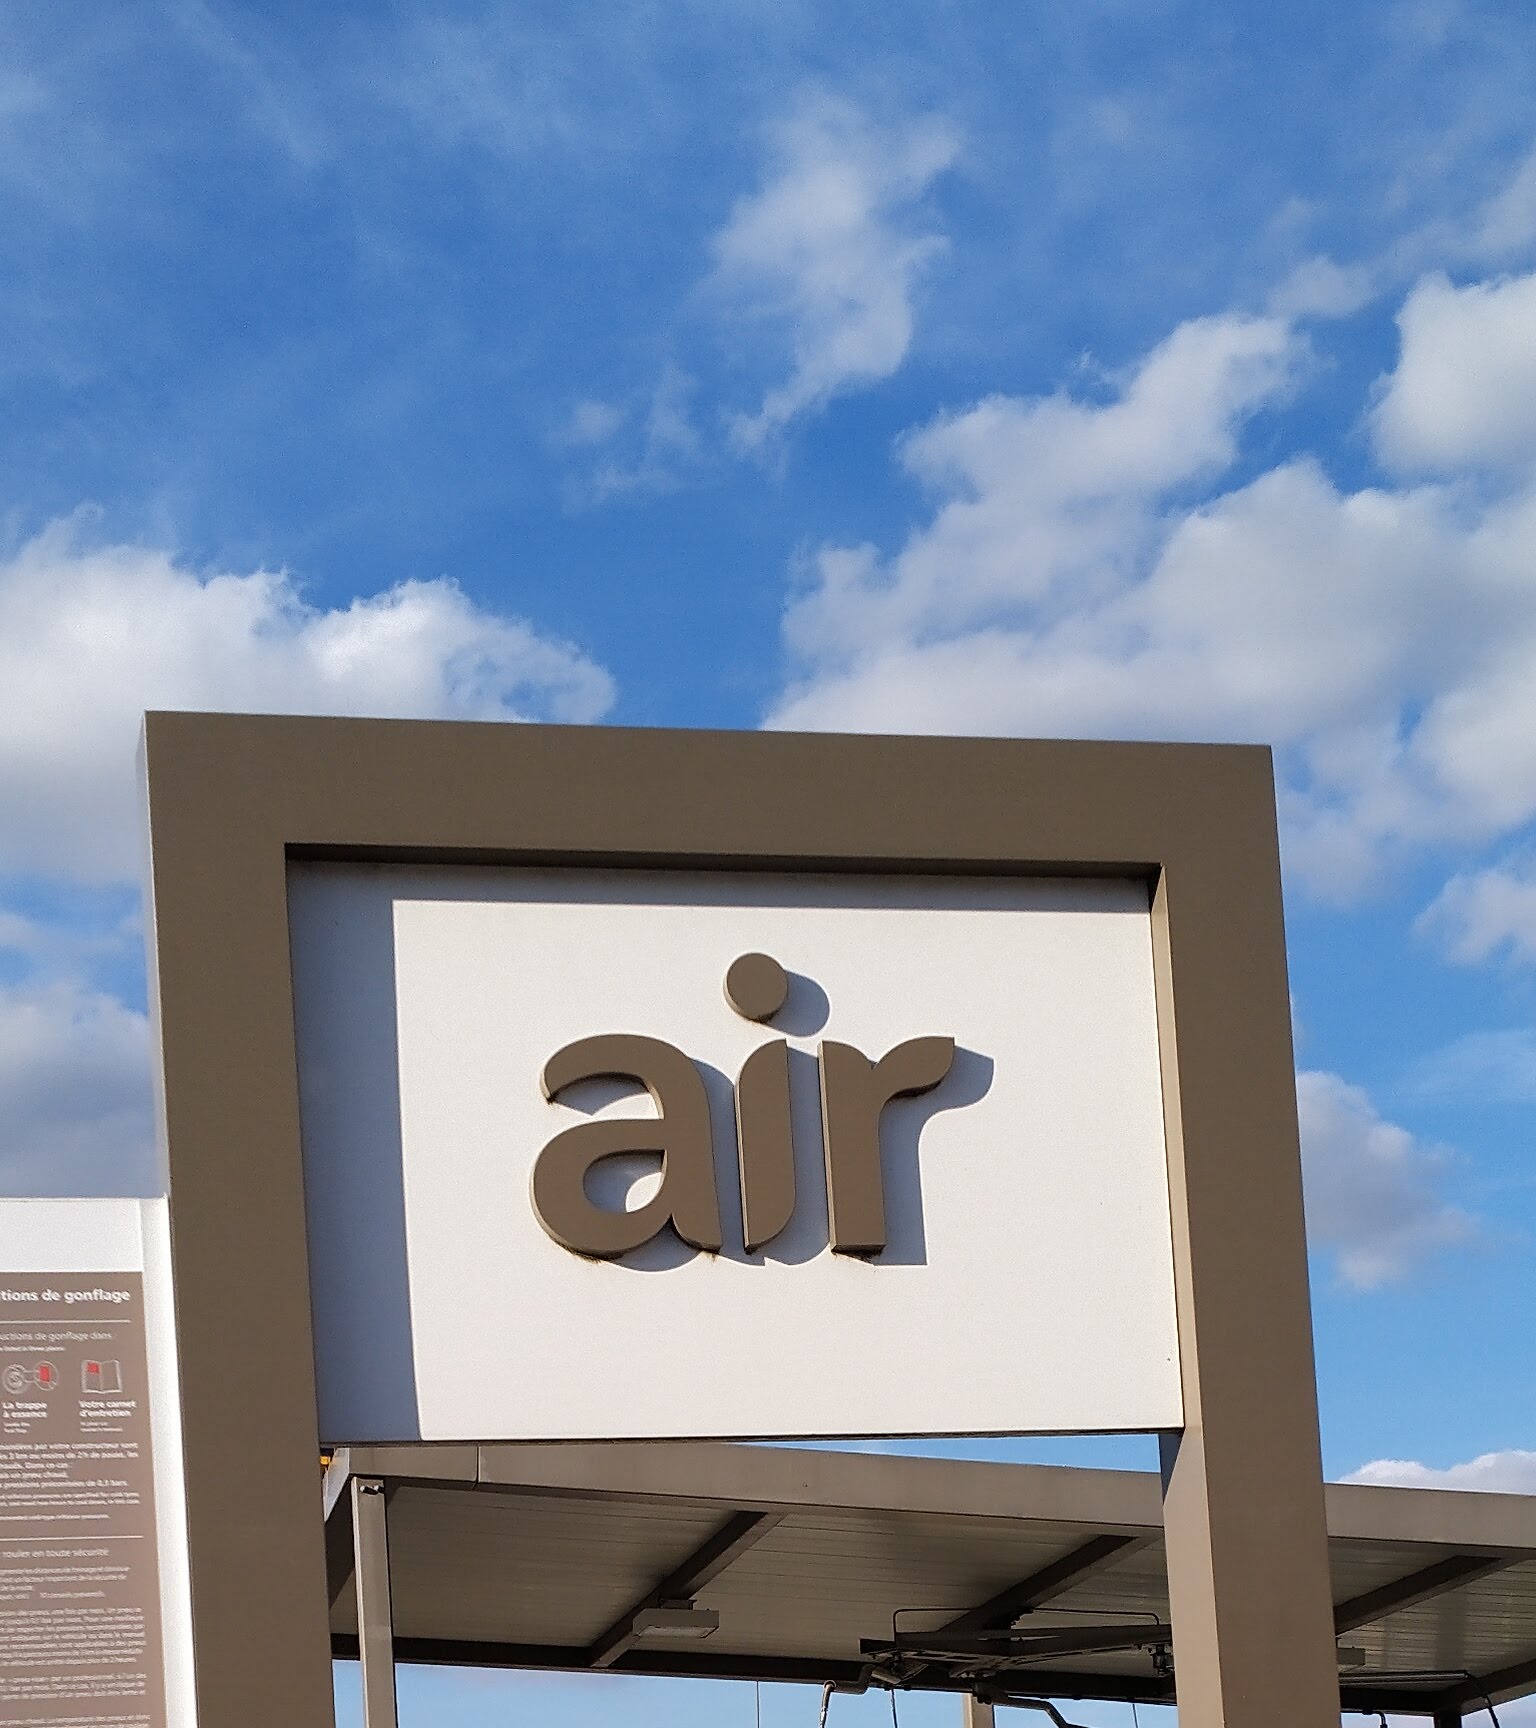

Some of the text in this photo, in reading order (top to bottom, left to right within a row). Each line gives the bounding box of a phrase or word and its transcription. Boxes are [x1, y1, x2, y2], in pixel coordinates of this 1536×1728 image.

[530, 952, 955, 1256] air
[41, 1288, 61, 1301] de
[64, 1288, 131, 1305] gonflage
